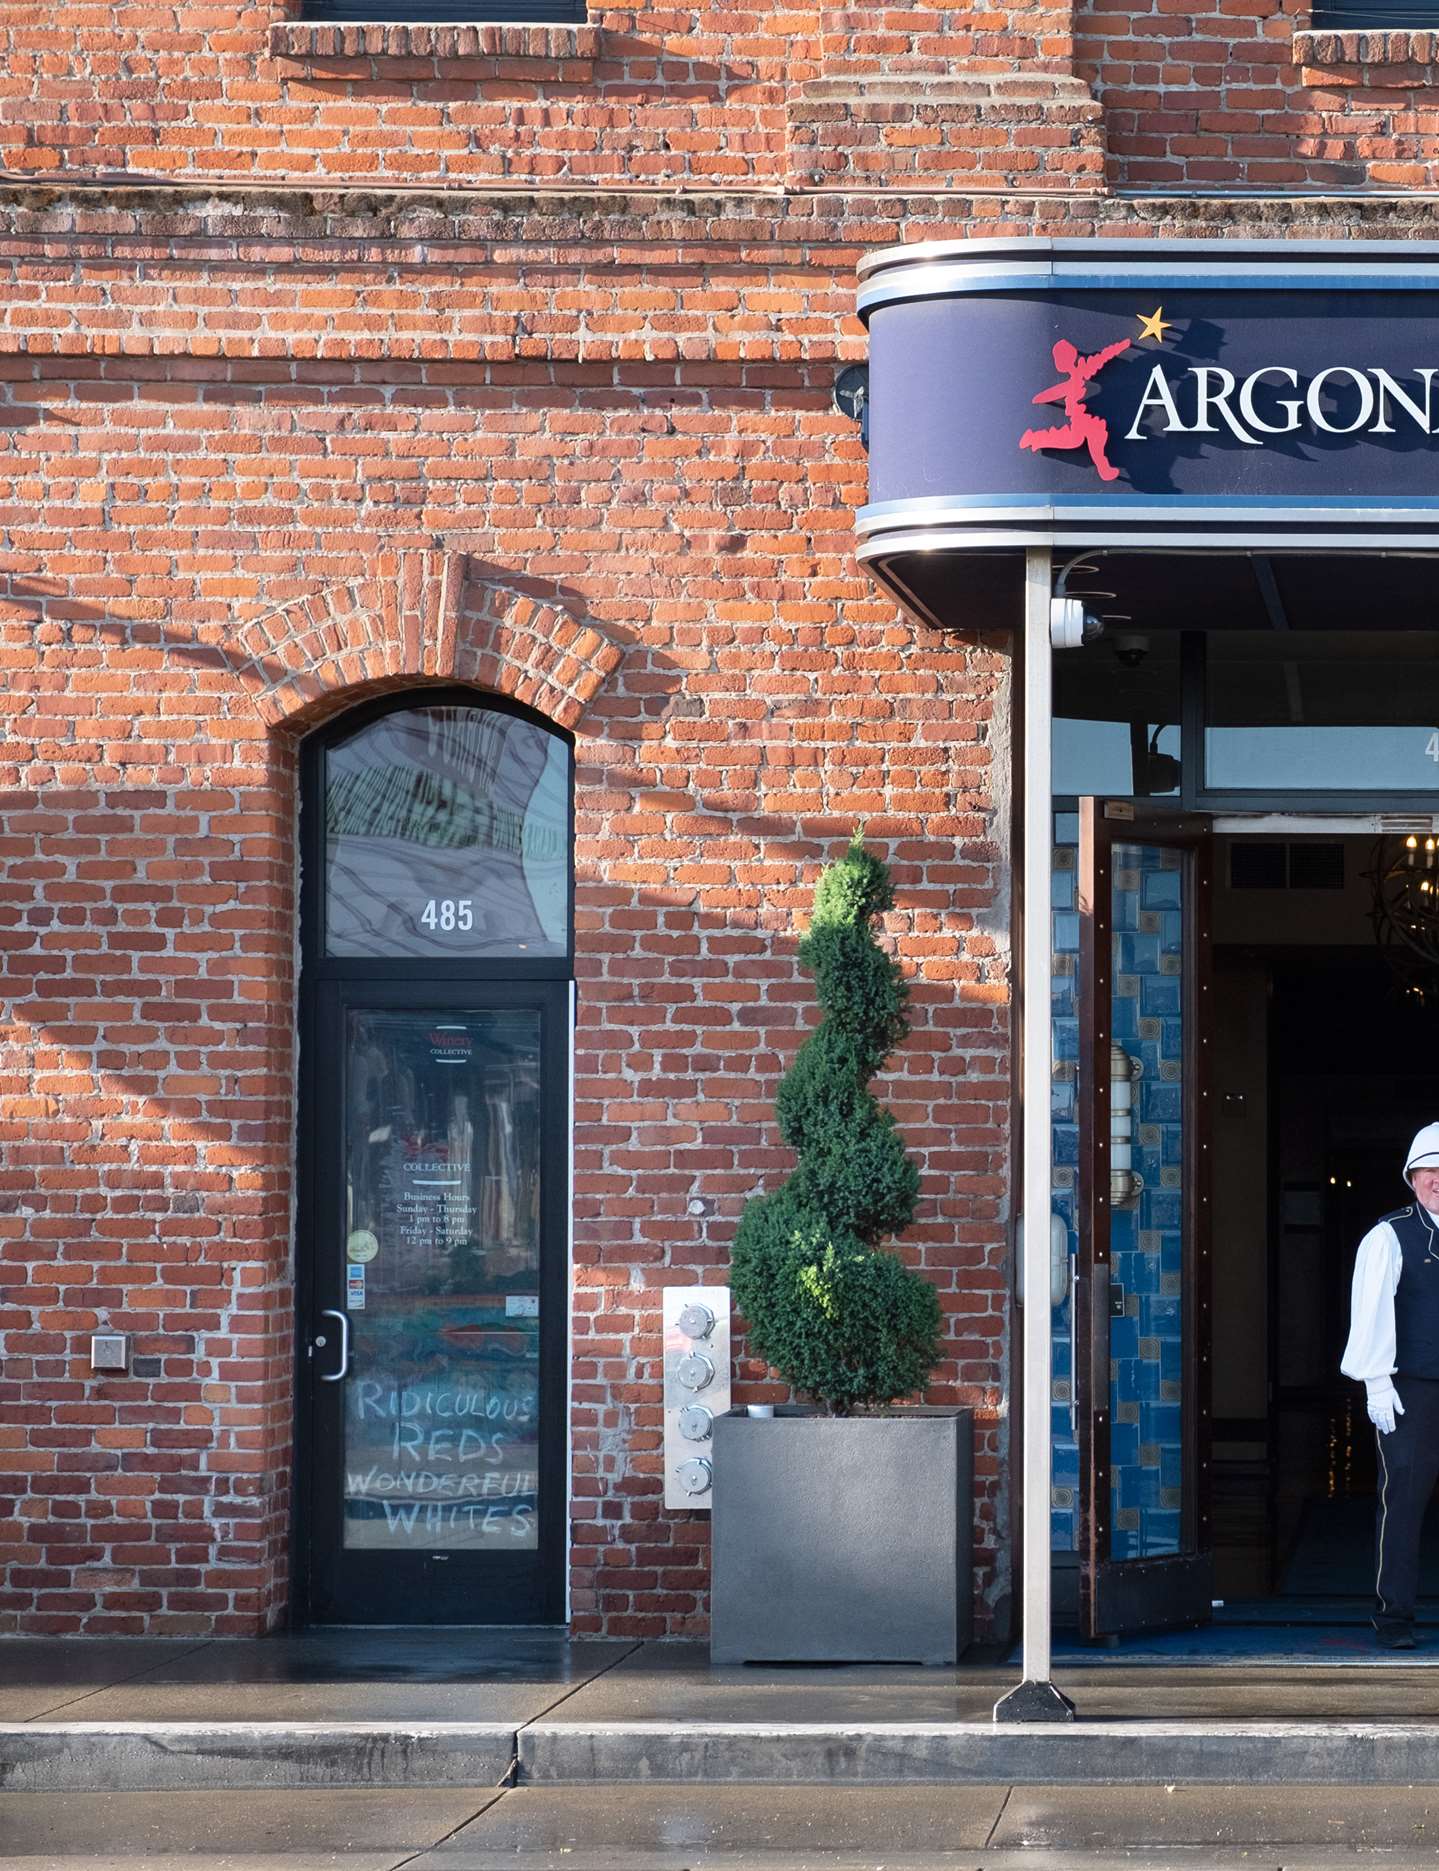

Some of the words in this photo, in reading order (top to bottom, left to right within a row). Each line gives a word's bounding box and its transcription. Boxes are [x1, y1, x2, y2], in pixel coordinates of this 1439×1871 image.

[421, 899, 473, 931] 485
[430, 1048, 473, 1056] COLLECTIVE
[403, 1162, 472, 1172] COLLECTIVE
[404, 1192, 441, 1201] Business
[443, 1192, 471, 1201] Hours
[396, 1203, 428, 1215] Sunday
[436, 1204, 477, 1215] Thursday
[416, 1216, 430, 1225] pm
[432, 1215, 441, 1223] to
[451, 1216, 465, 1225] pm
[400, 1225, 426, 1237] Friday
[435, 1225, 473, 1237] Saturday
[406, 1236, 417, 1245] 12
[419, 1238, 432, 1247] pm
[434, 1237, 444, 1245] to
[454, 1238, 468, 1247] pm
[392, 1421, 504, 1464] REDS
[383, 1500, 535, 1538] WHITES
